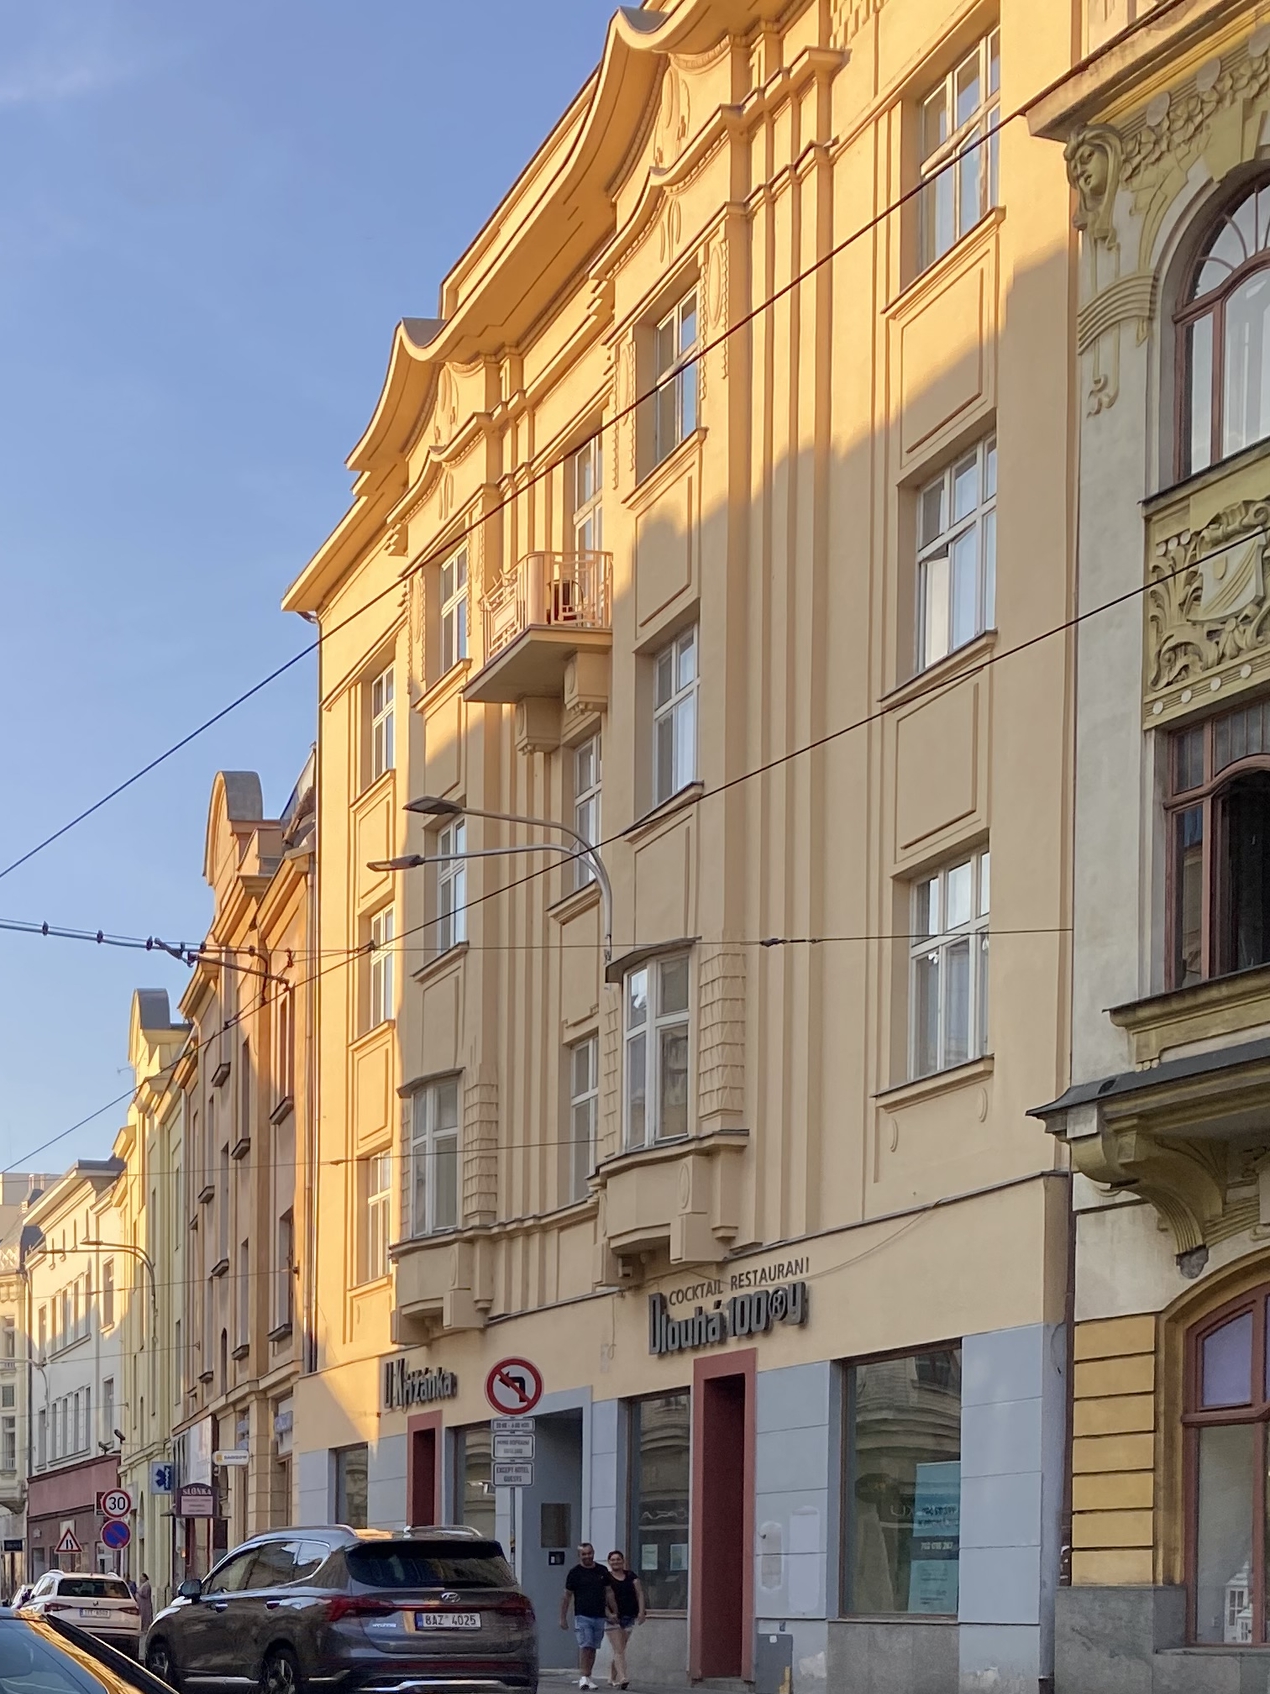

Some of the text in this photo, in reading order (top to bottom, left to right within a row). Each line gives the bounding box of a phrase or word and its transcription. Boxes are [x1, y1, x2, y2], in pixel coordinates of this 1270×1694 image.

[668, 1279, 724, 1306] COCKTAIL
[648, 1291, 726, 1355] Dlouhá
[108, 1496, 126, 1510] 30
[451, 1615, 477, 1625] 4025
